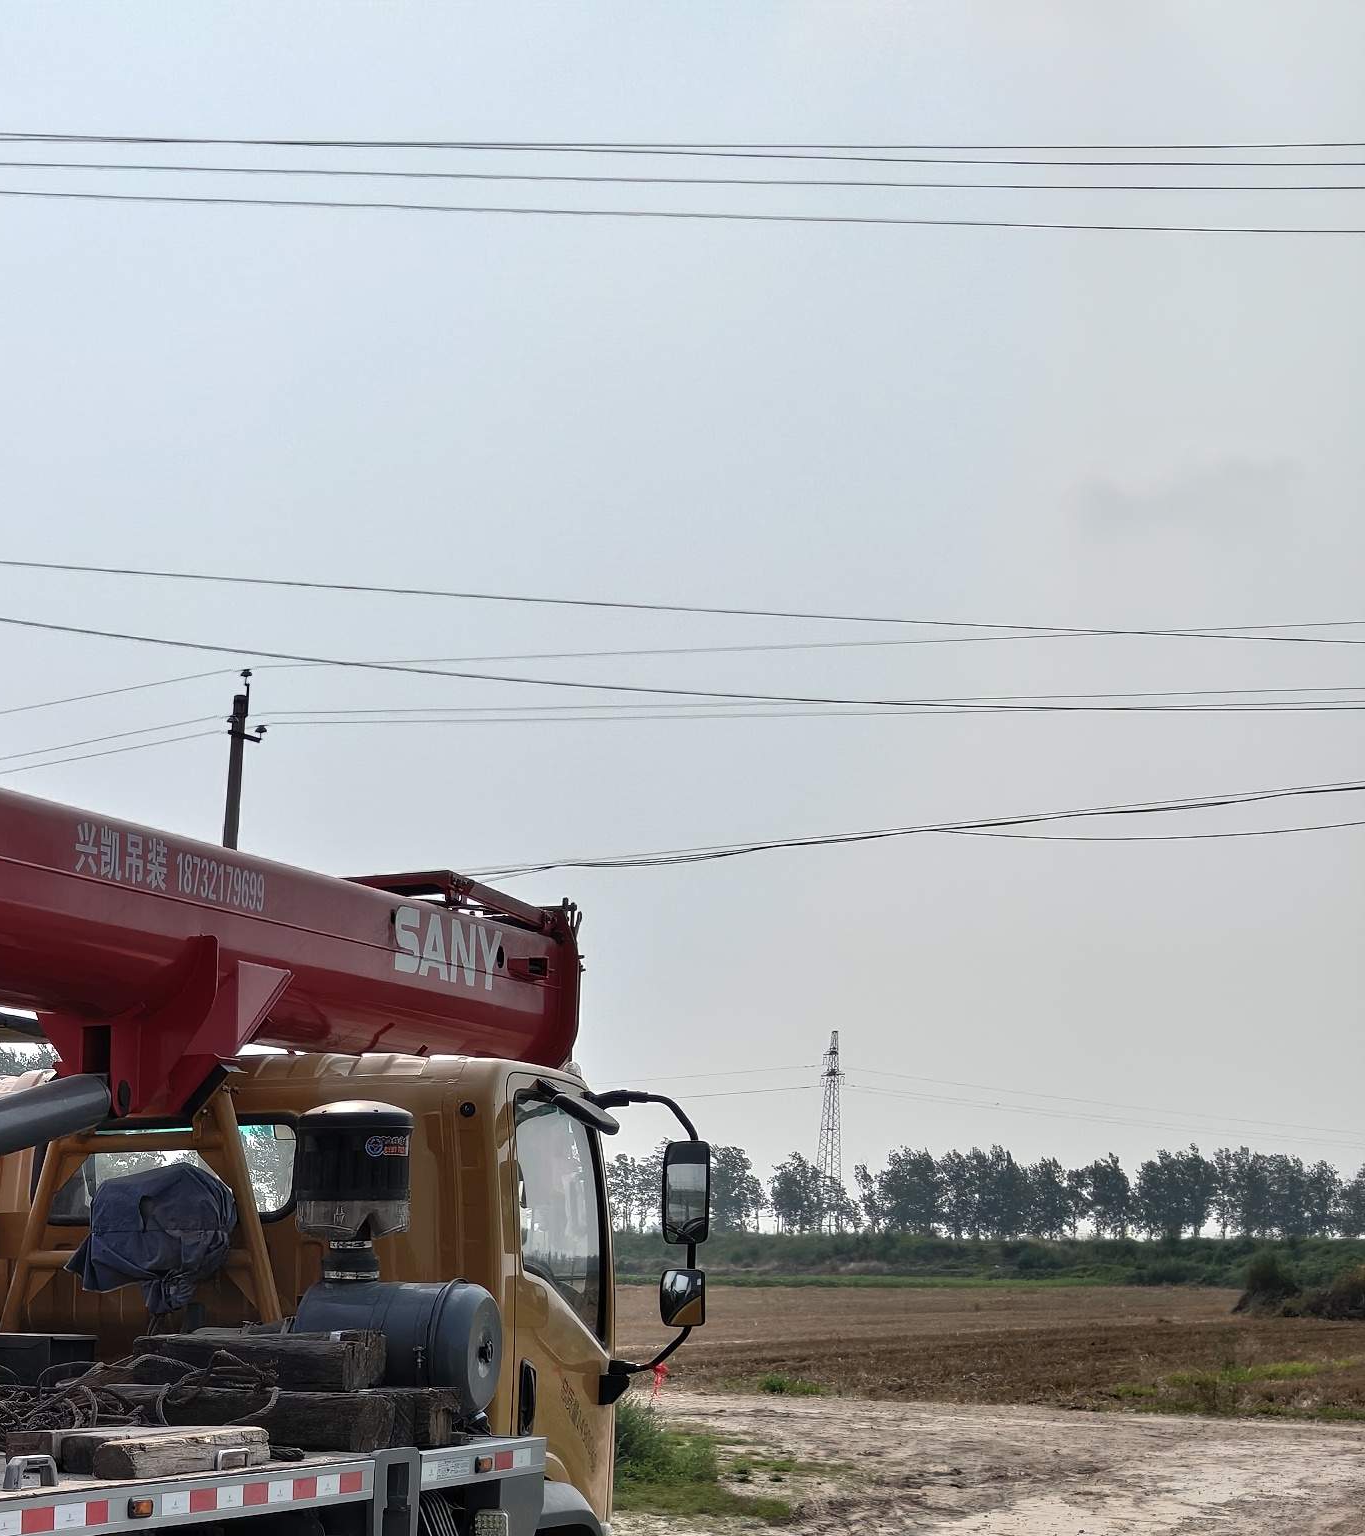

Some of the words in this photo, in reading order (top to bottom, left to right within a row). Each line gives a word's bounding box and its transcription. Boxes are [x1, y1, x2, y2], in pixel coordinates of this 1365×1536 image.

[75, 822, 168, 891] 兴凯吊装
[176, 852, 265, 912] 18732179699
[395, 906, 503, 991] SANY
